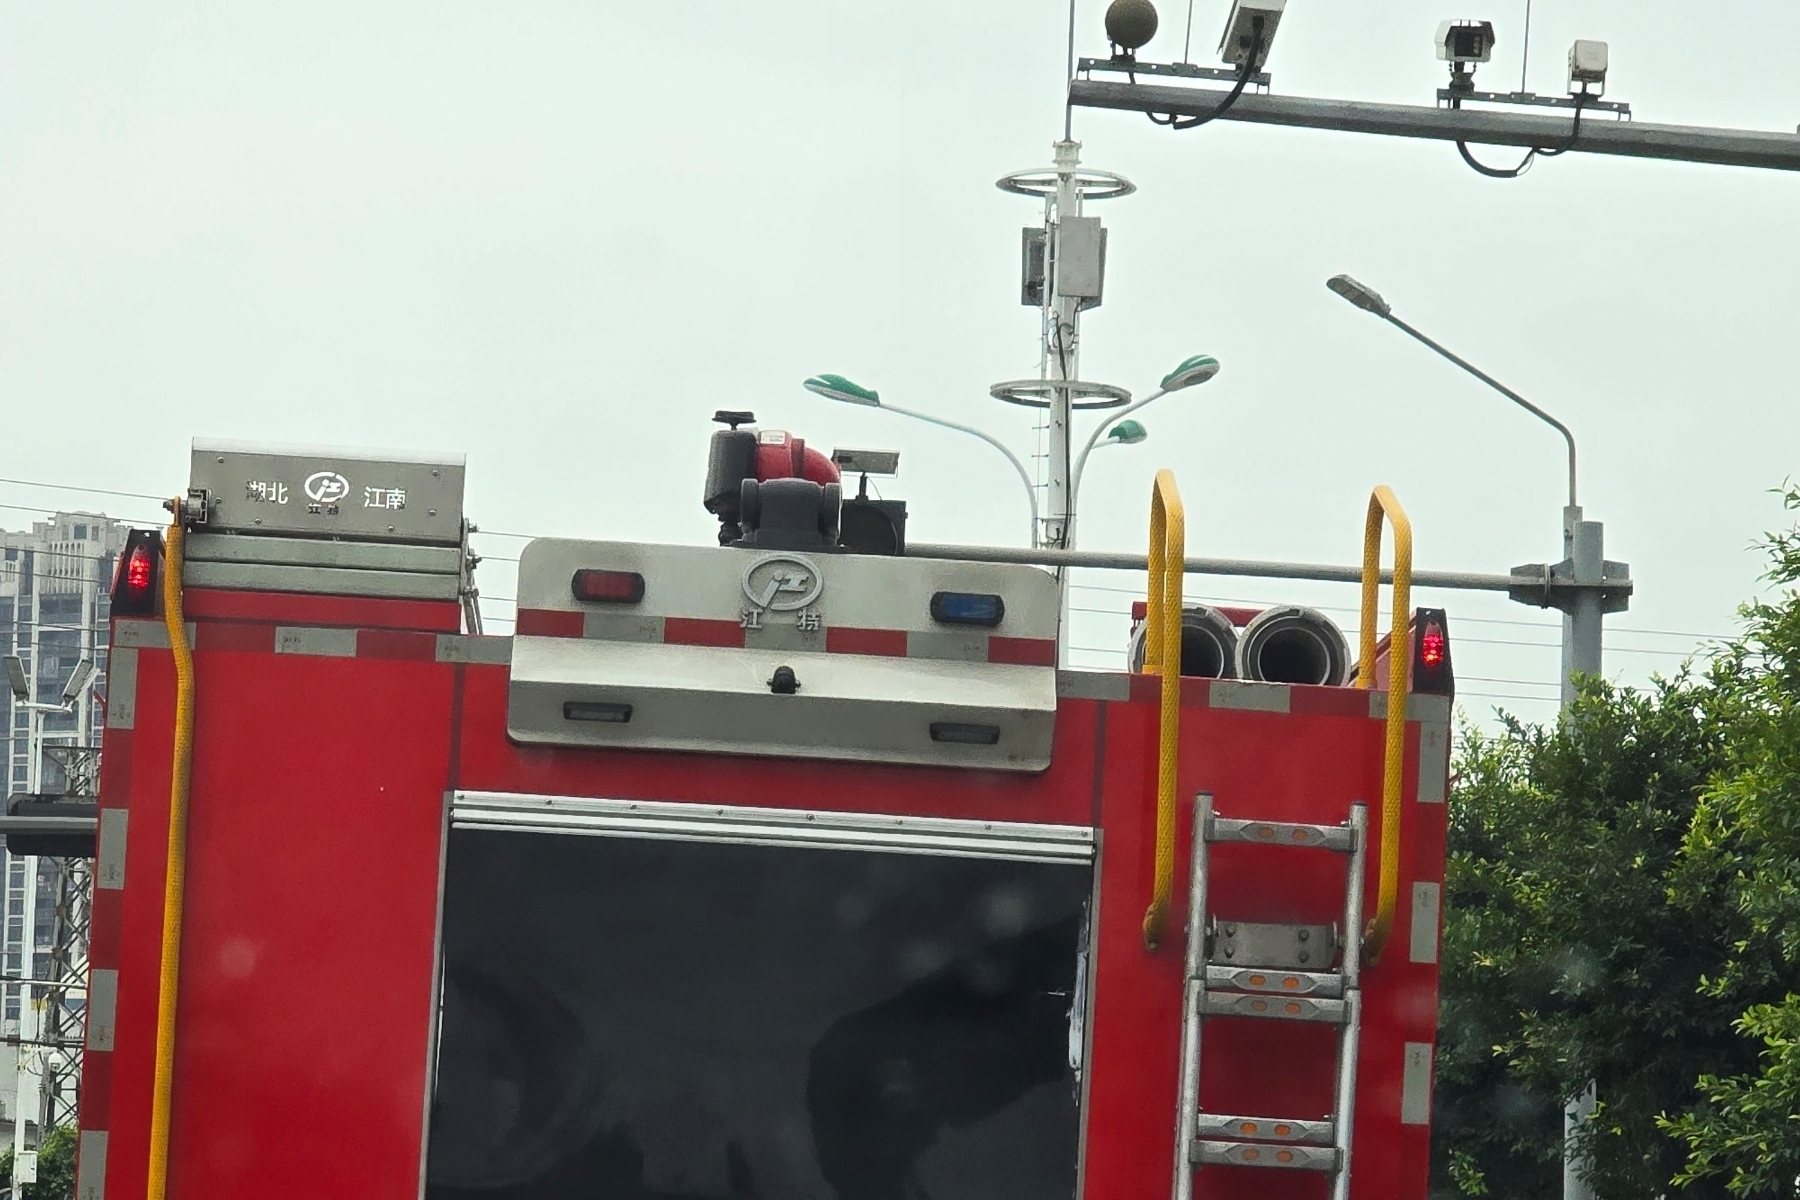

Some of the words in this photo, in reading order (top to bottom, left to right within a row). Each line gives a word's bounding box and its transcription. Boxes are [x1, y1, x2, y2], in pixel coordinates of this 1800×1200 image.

[246, 479, 289, 505] 湖北
[364, 486, 406, 509] 江南
[740, 607, 820, 631] 江特
